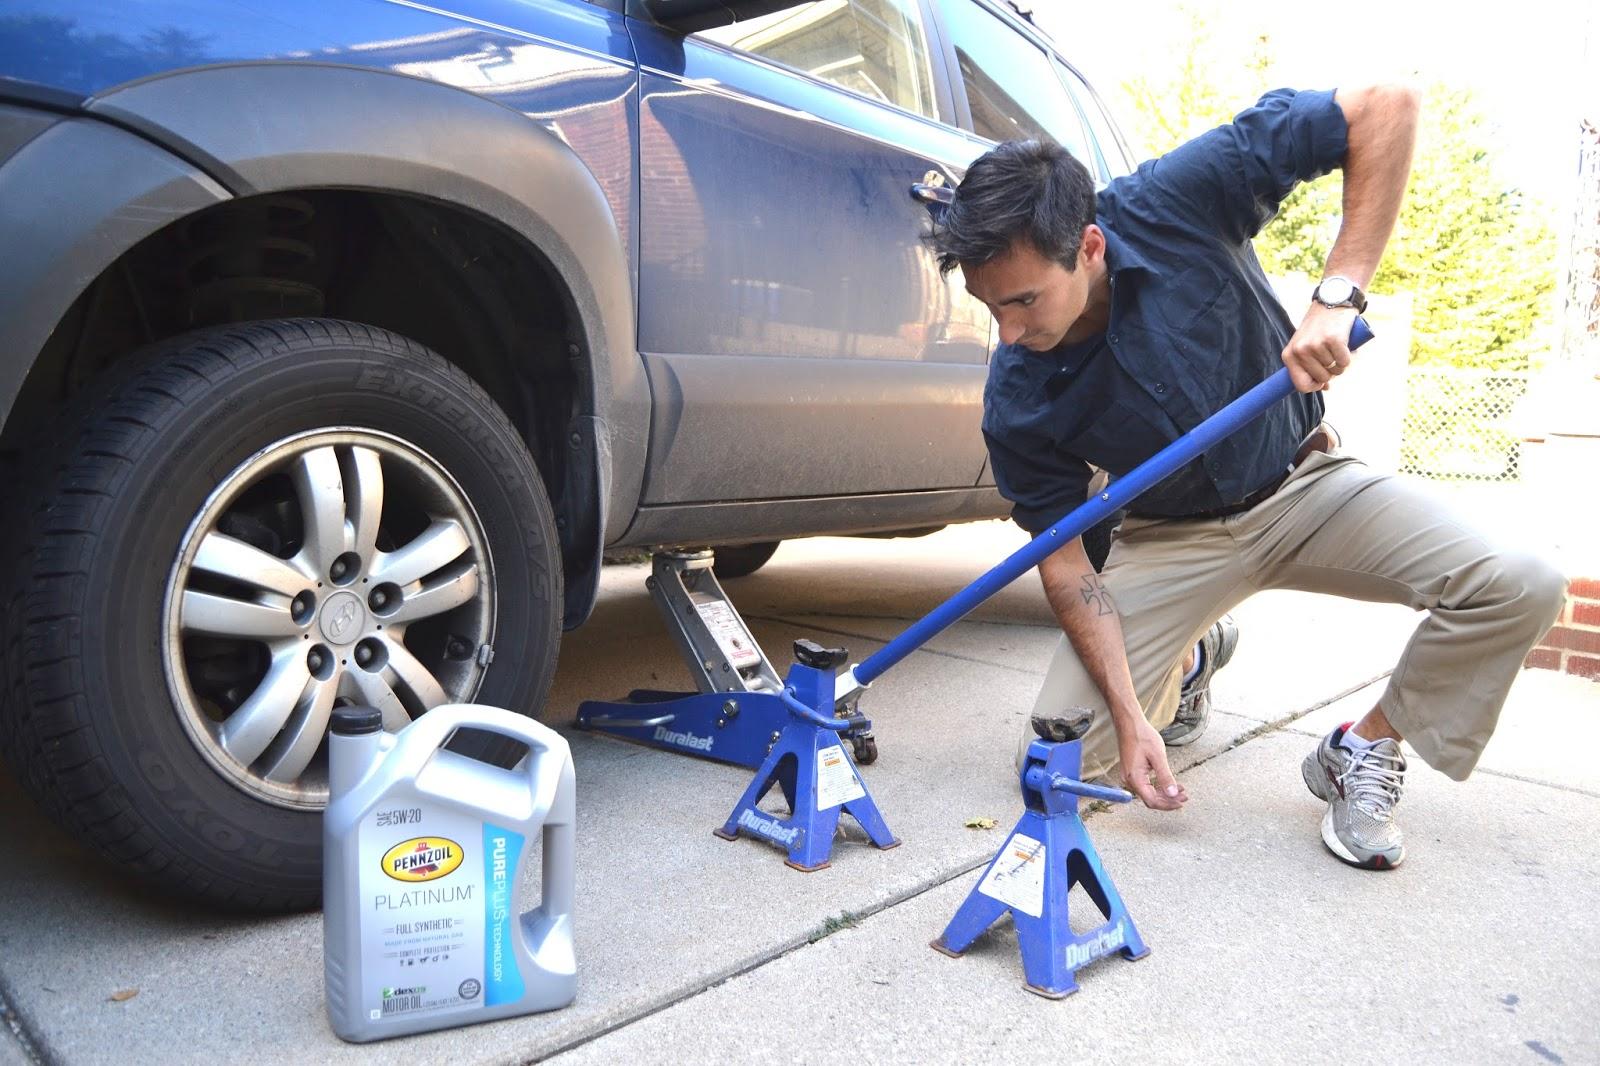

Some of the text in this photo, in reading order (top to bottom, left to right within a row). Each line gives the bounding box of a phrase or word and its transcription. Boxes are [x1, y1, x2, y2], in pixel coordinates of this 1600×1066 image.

[653, 725, 715, 752] Duralast
[393, 808, 422, 825] 5W-20
[738, 808, 799, 845] Duralast
[394, 846, 453, 872] PENNZOIL
[375, 885, 473, 910] PLATINUM
[396, 918, 453, 934] FULL SYNTHETIC
[493, 922, 503, 982] TECHNOLOGY
[1065, 915, 1126, 971] Duralast
[382, 996, 410, 1014] MOTOR
[410, 994, 422, 1010] OIL
